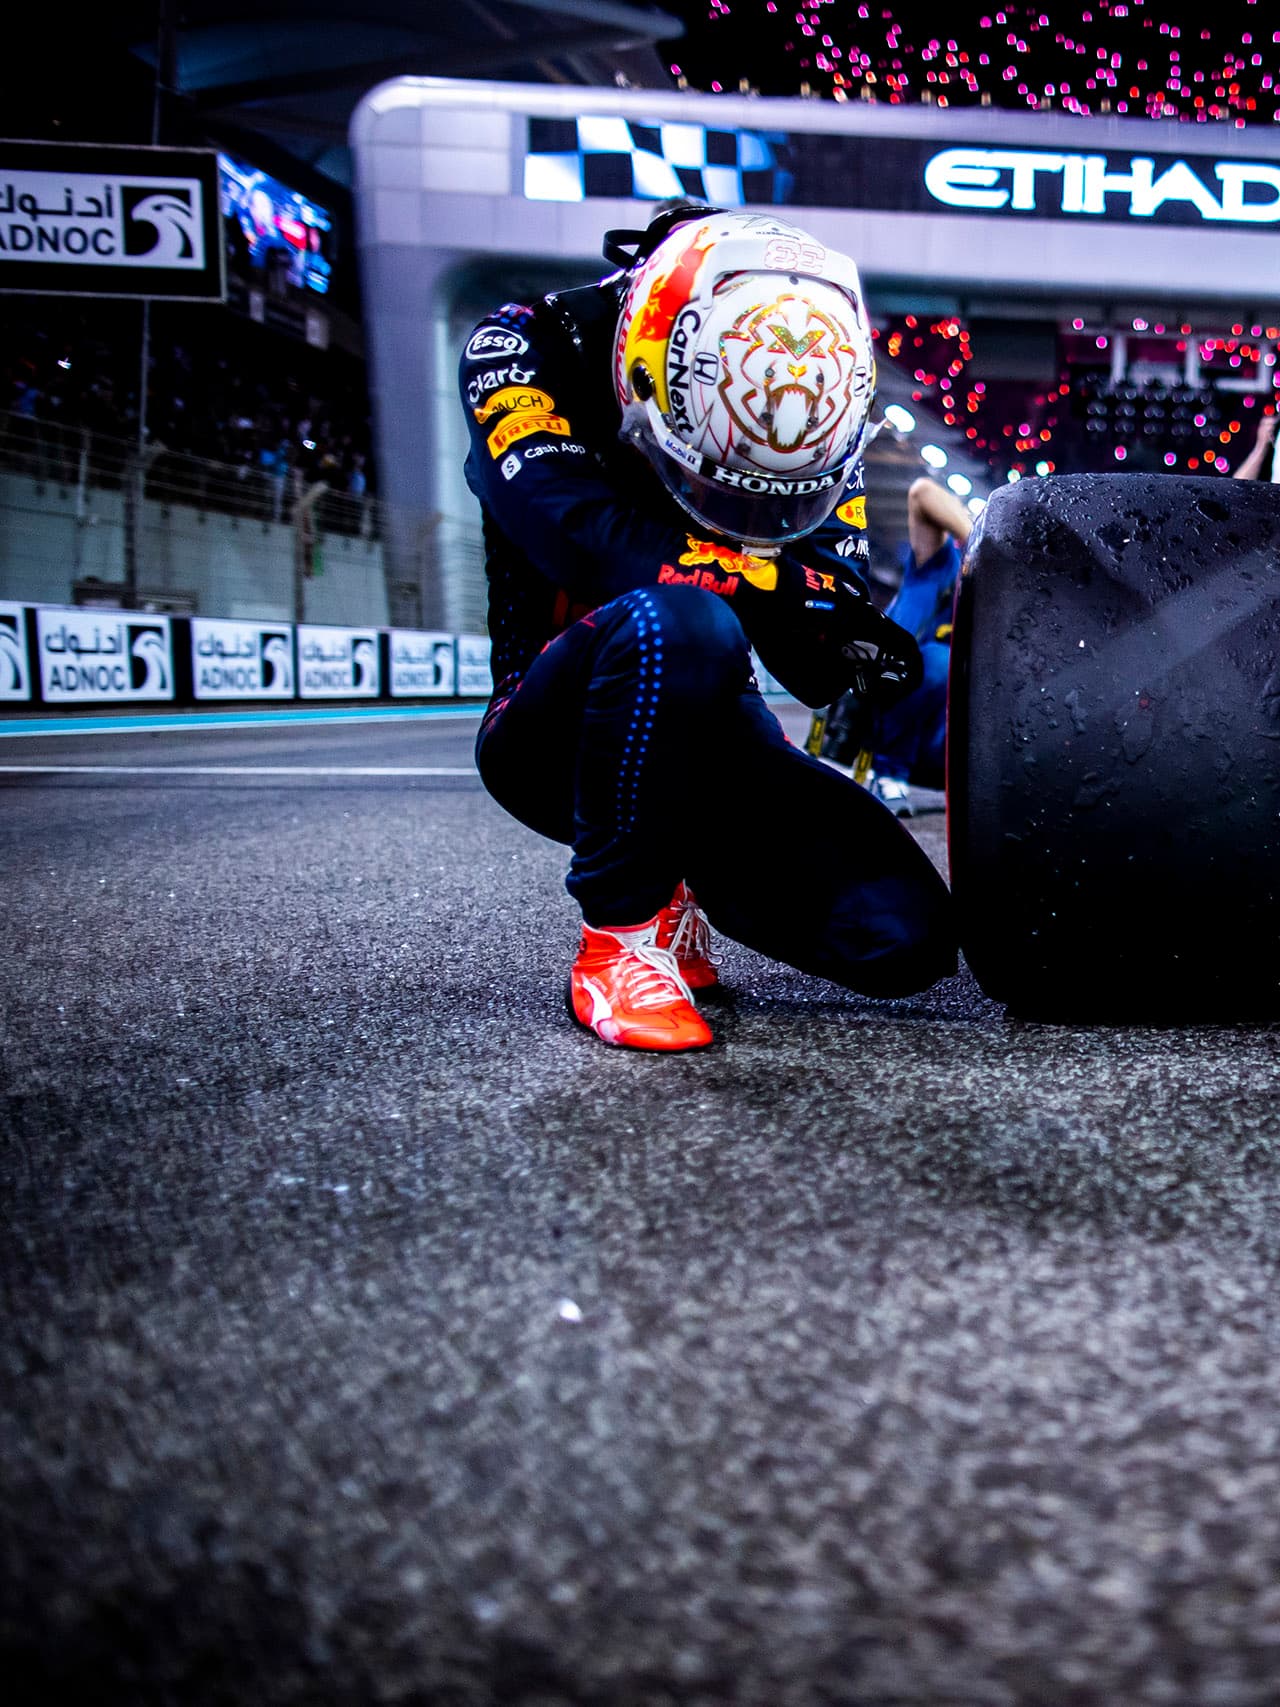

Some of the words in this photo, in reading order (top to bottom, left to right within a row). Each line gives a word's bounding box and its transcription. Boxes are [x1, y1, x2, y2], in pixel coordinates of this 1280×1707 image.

[668, 309, 701, 434] CarNext
[524, 444, 559, 458] Cash
[561, 442, 586, 455] App
[712, 465, 836, 496] HONDA
[657, 564, 701, 586] Red
[700, 571, 739, 597] Bull
[50, 665, 125, 691] ADNOC
